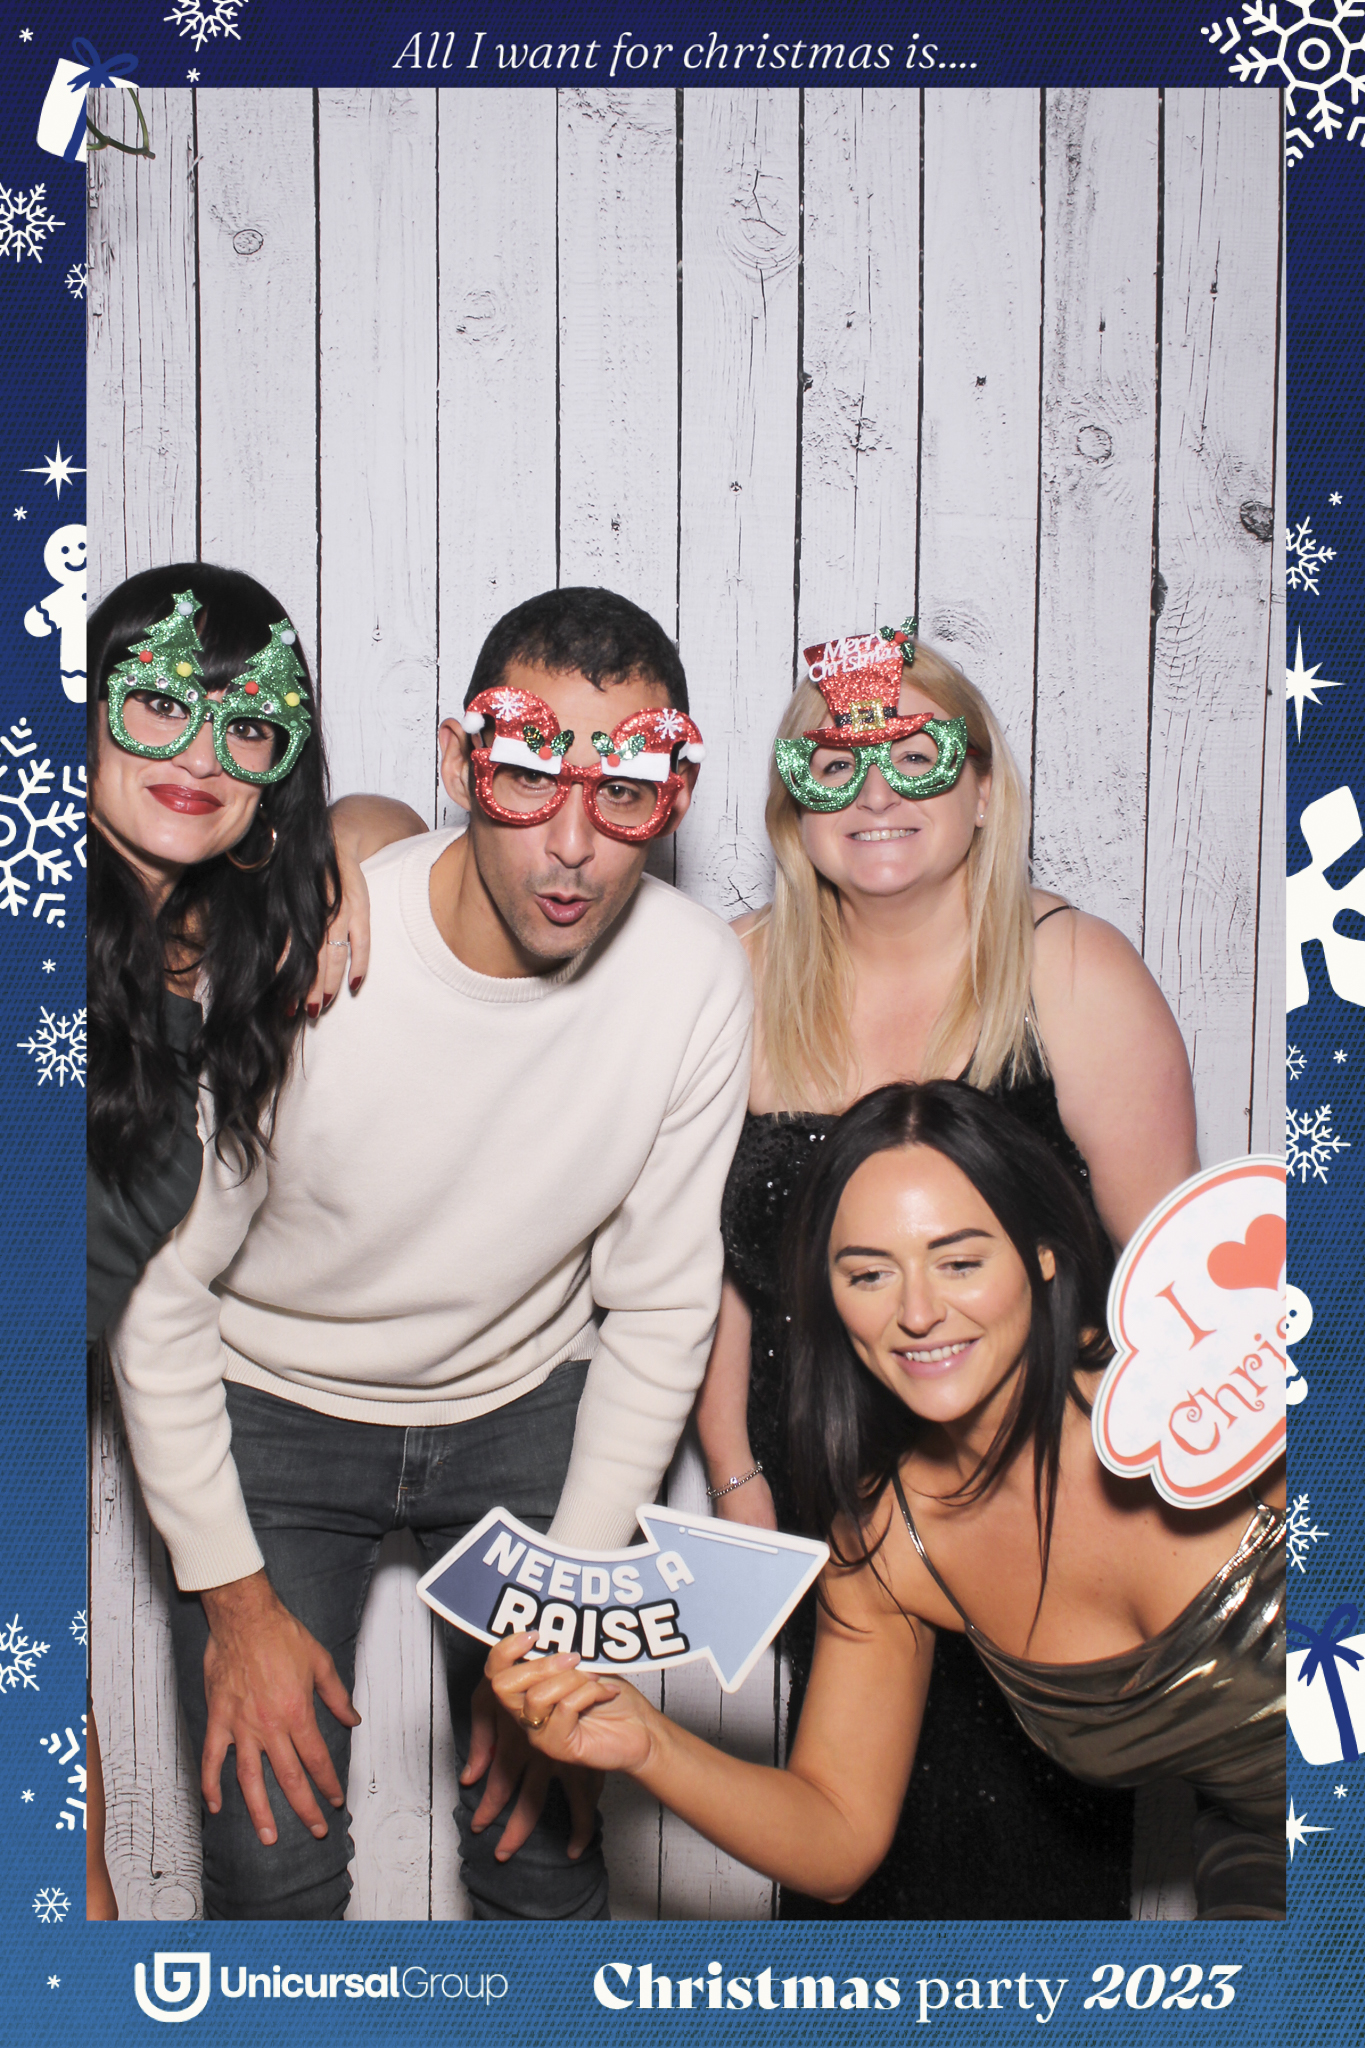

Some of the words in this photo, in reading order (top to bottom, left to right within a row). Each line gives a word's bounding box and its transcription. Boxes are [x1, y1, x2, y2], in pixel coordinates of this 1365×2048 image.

[808, 645, 901, 683] Christmas
[823, 632, 887, 661] Merry
[1154, 1280, 1218, 1351] I
[482, 1530, 644, 1605] NEEDS
[654, 1550, 696, 1593] A
[489, 1584, 687, 1662] RAISE
